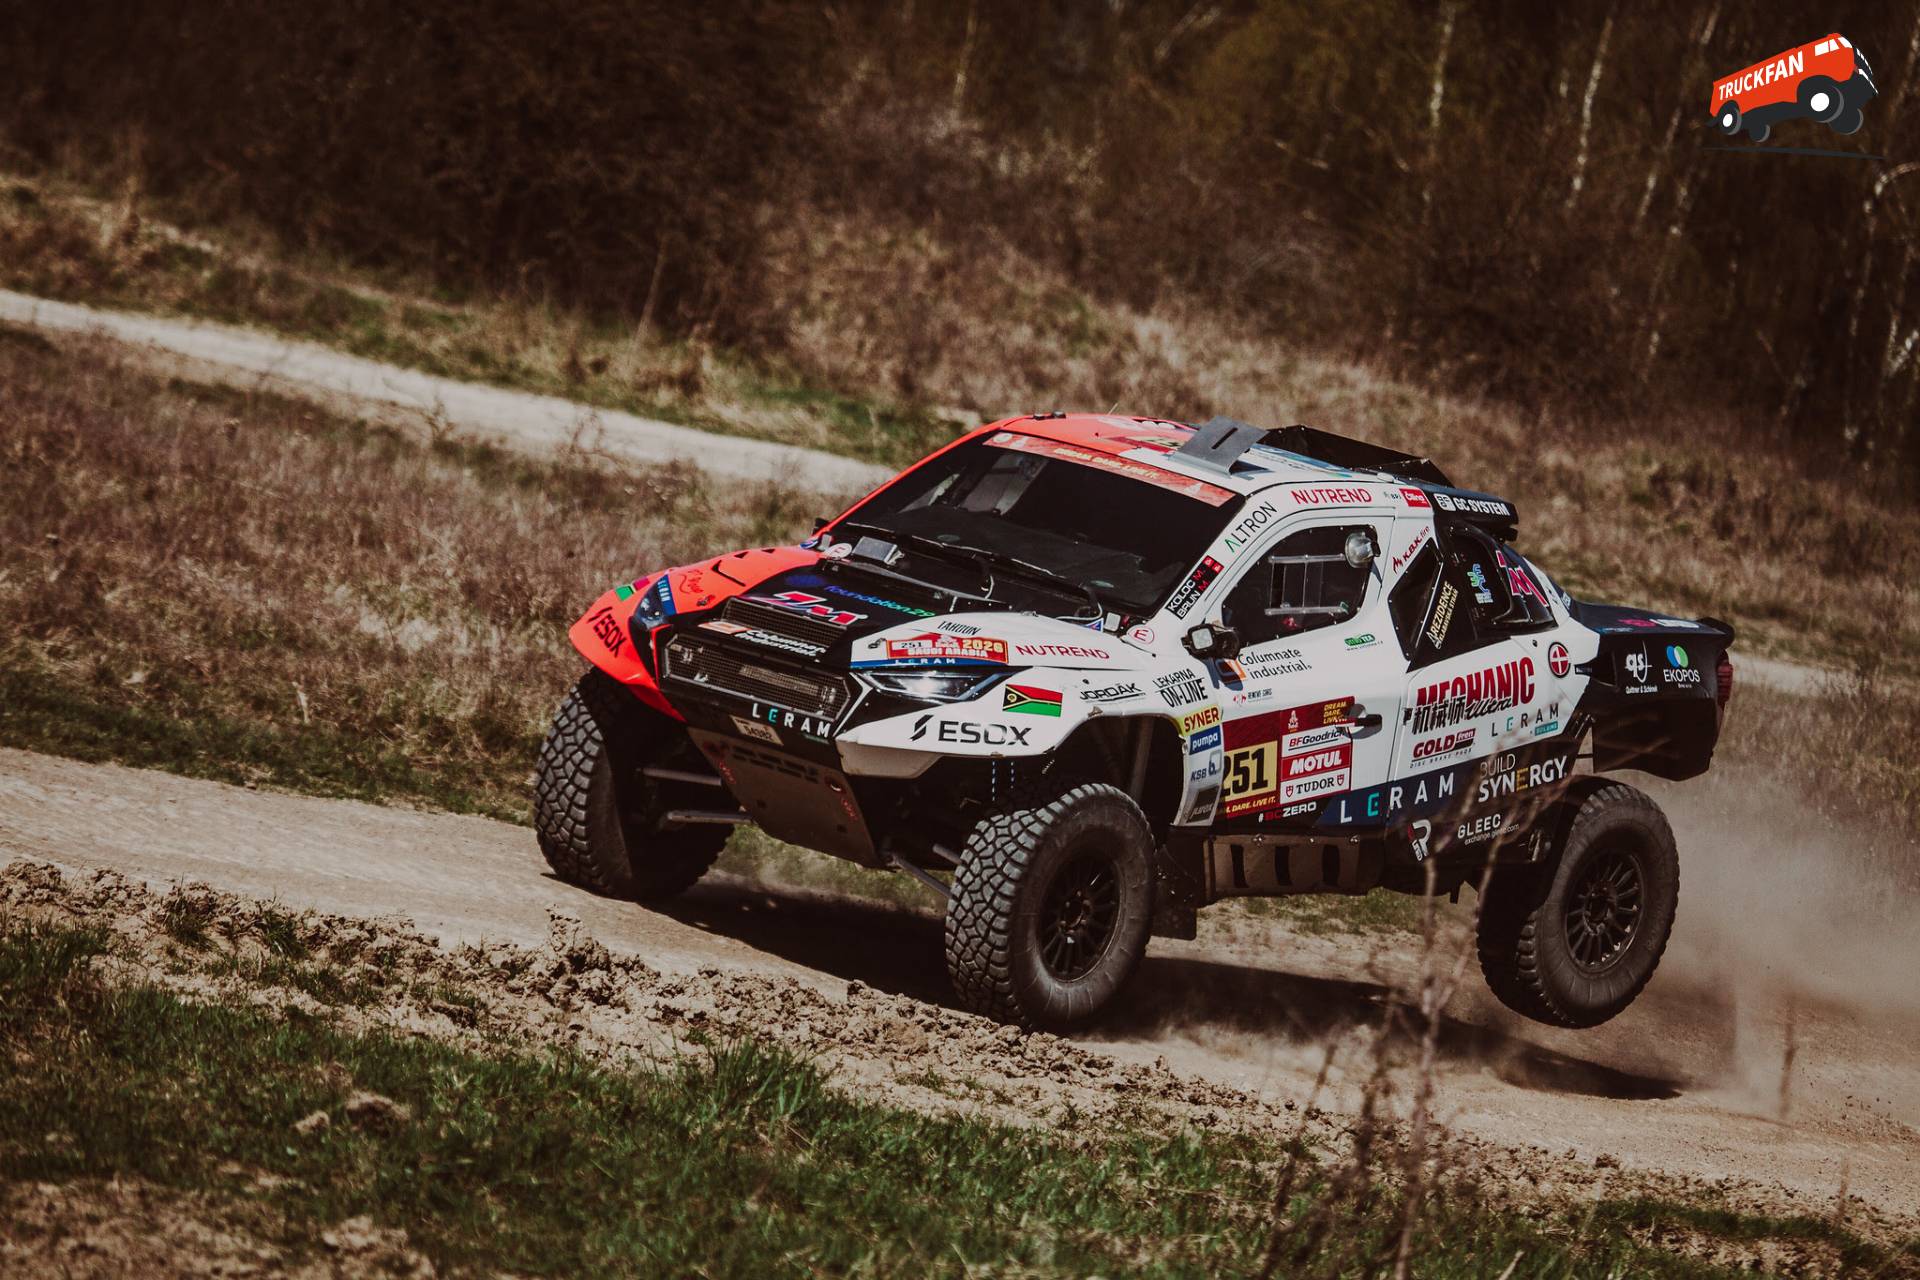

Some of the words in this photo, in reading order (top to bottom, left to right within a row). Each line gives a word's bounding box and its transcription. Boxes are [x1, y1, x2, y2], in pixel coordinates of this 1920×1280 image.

[1291, 488, 1373, 505] NUTREND
[1468, 499, 1511, 516] SYSTEM
[1225, 501, 1278, 553] ALTRON
[1167, 579, 1196, 612] KOLOC
[1176, 590, 1201, 619] BRUN
[1430, 580, 1454, 636] REZIDENCE
[592, 611, 627, 658] ESOX
[1015, 645, 1110, 660] NUTREND
[1237, 648, 1302, 667] Columnate
[1663, 669, 1701, 683] EKOPOS
[1160, 677, 1209, 708] ON-LINE
[752, 702, 831, 738] LERAM
[1183, 705, 1220, 733] SYNER
[1491, 702, 1560, 737] LERAM
[938, 720, 1032, 746] ESOX
[1191, 732, 1218, 750] pumpa
[1412, 734, 1456, 760] GOLD
[1190, 766, 1207, 782] KSB
[1289, 750, 1342, 775] MOTUL
[1296, 777, 1335, 794] TUDOR
[1478, 755, 1568, 803] SYNERGY
[1340, 771, 1455, 824] LERAM
[1457, 813, 1501, 839] GLEEC
